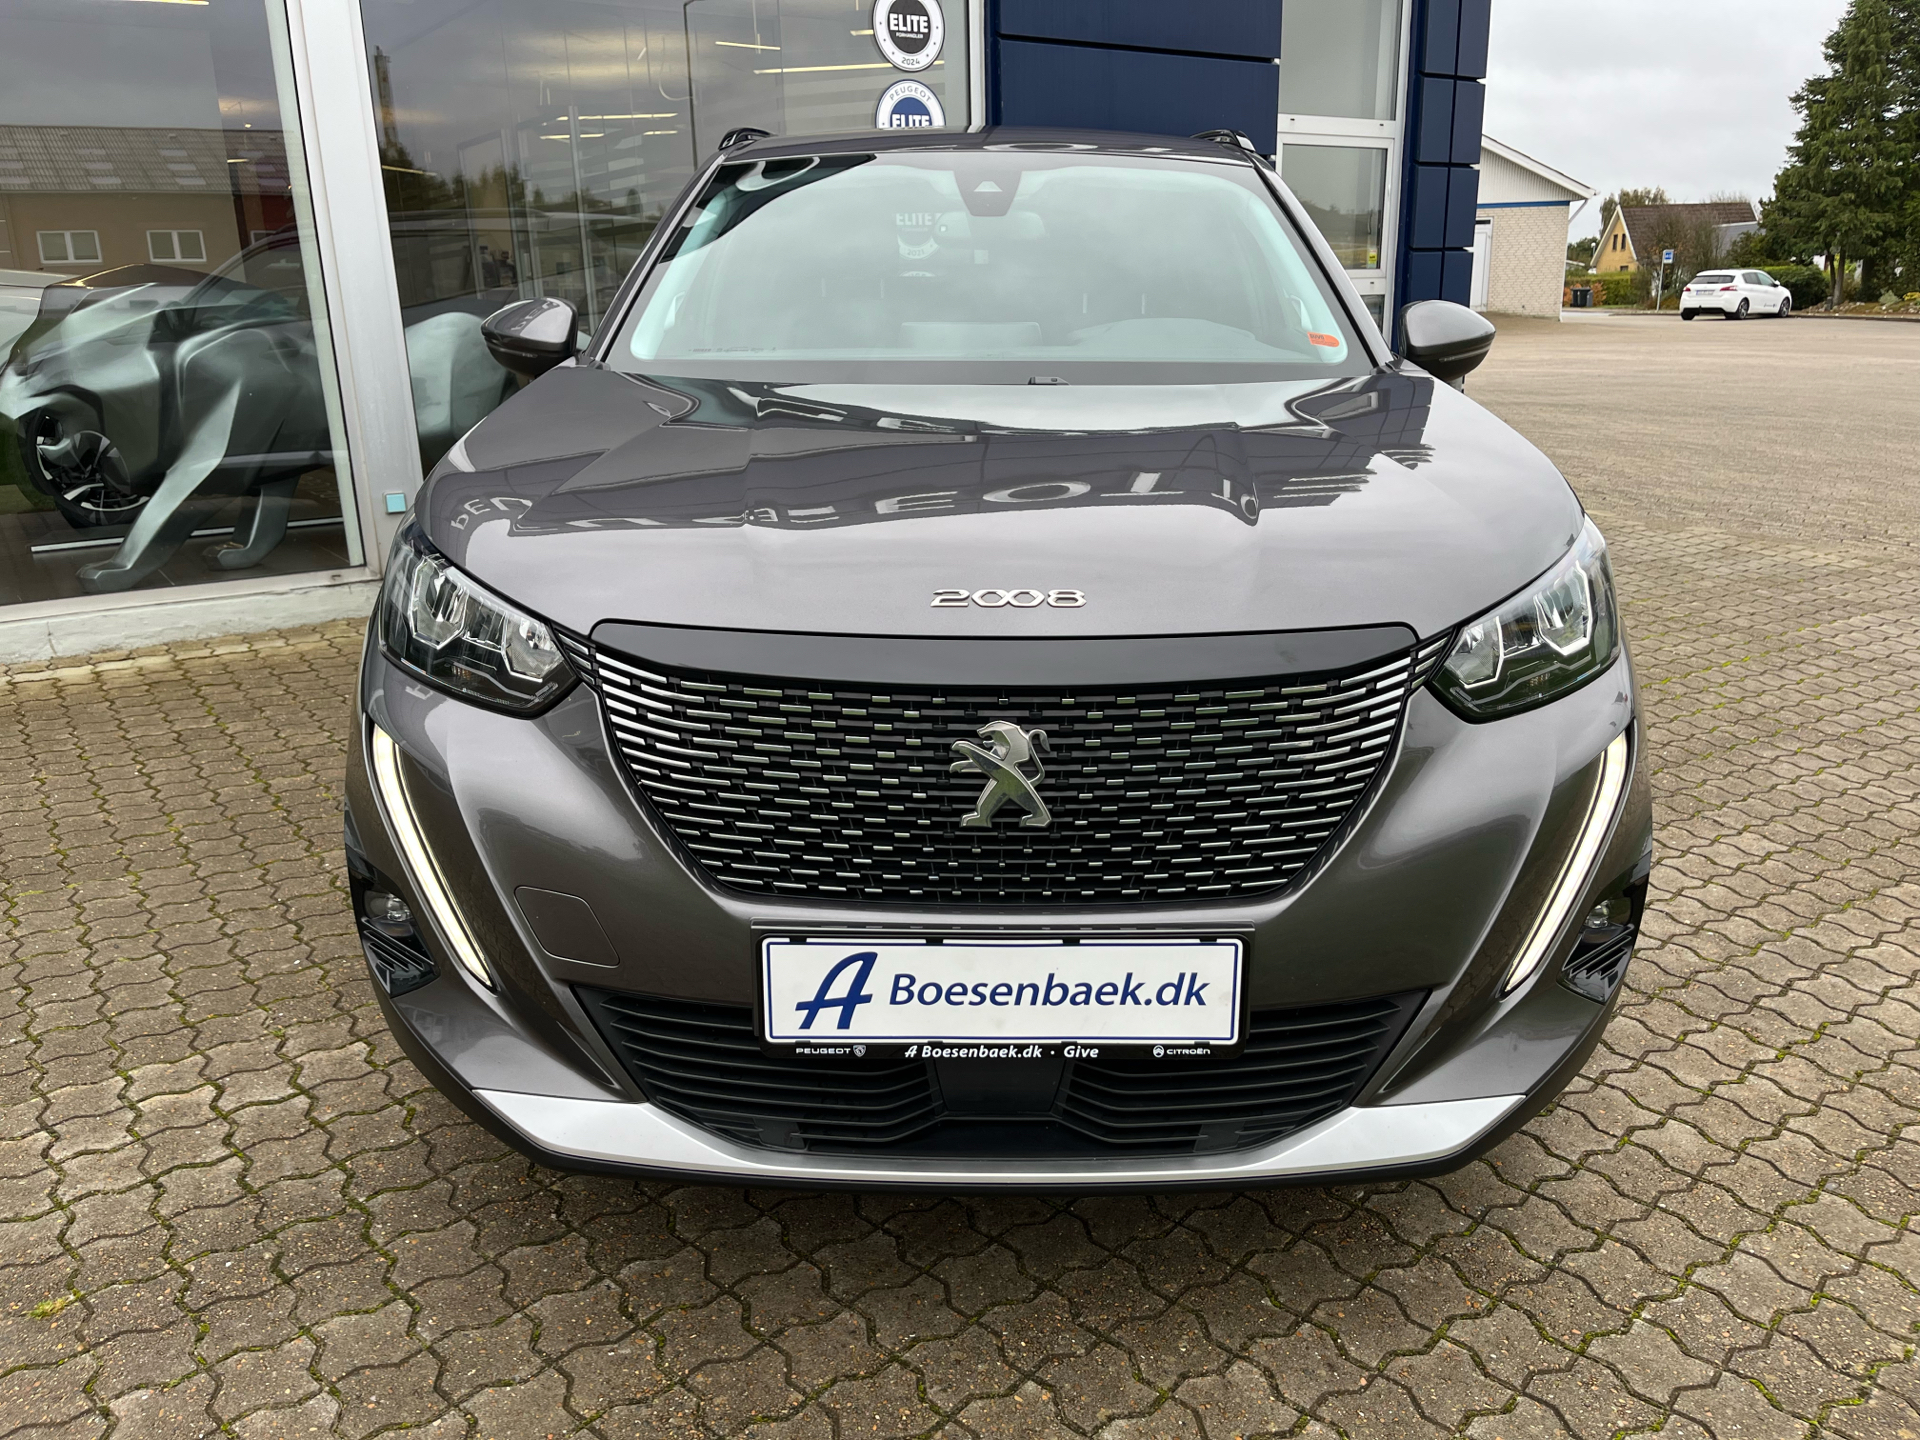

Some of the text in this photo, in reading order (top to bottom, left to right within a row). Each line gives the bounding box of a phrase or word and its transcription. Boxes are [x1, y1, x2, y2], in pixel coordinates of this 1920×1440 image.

[889, 13, 929, 33] ELITE
[901, 56, 921, 66] 2024
[889, 85, 932, 102] PEUGEOT
[896, 212, 932, 226] ELITE
[930, 588, 1087, 608] 2008
[889, 972, 1211, 1006] Boesenbaek.dk
[921, 1045, 1042, 1058] Boesenbaek.dk
[1063, 1045, 1099, 1058] Give
